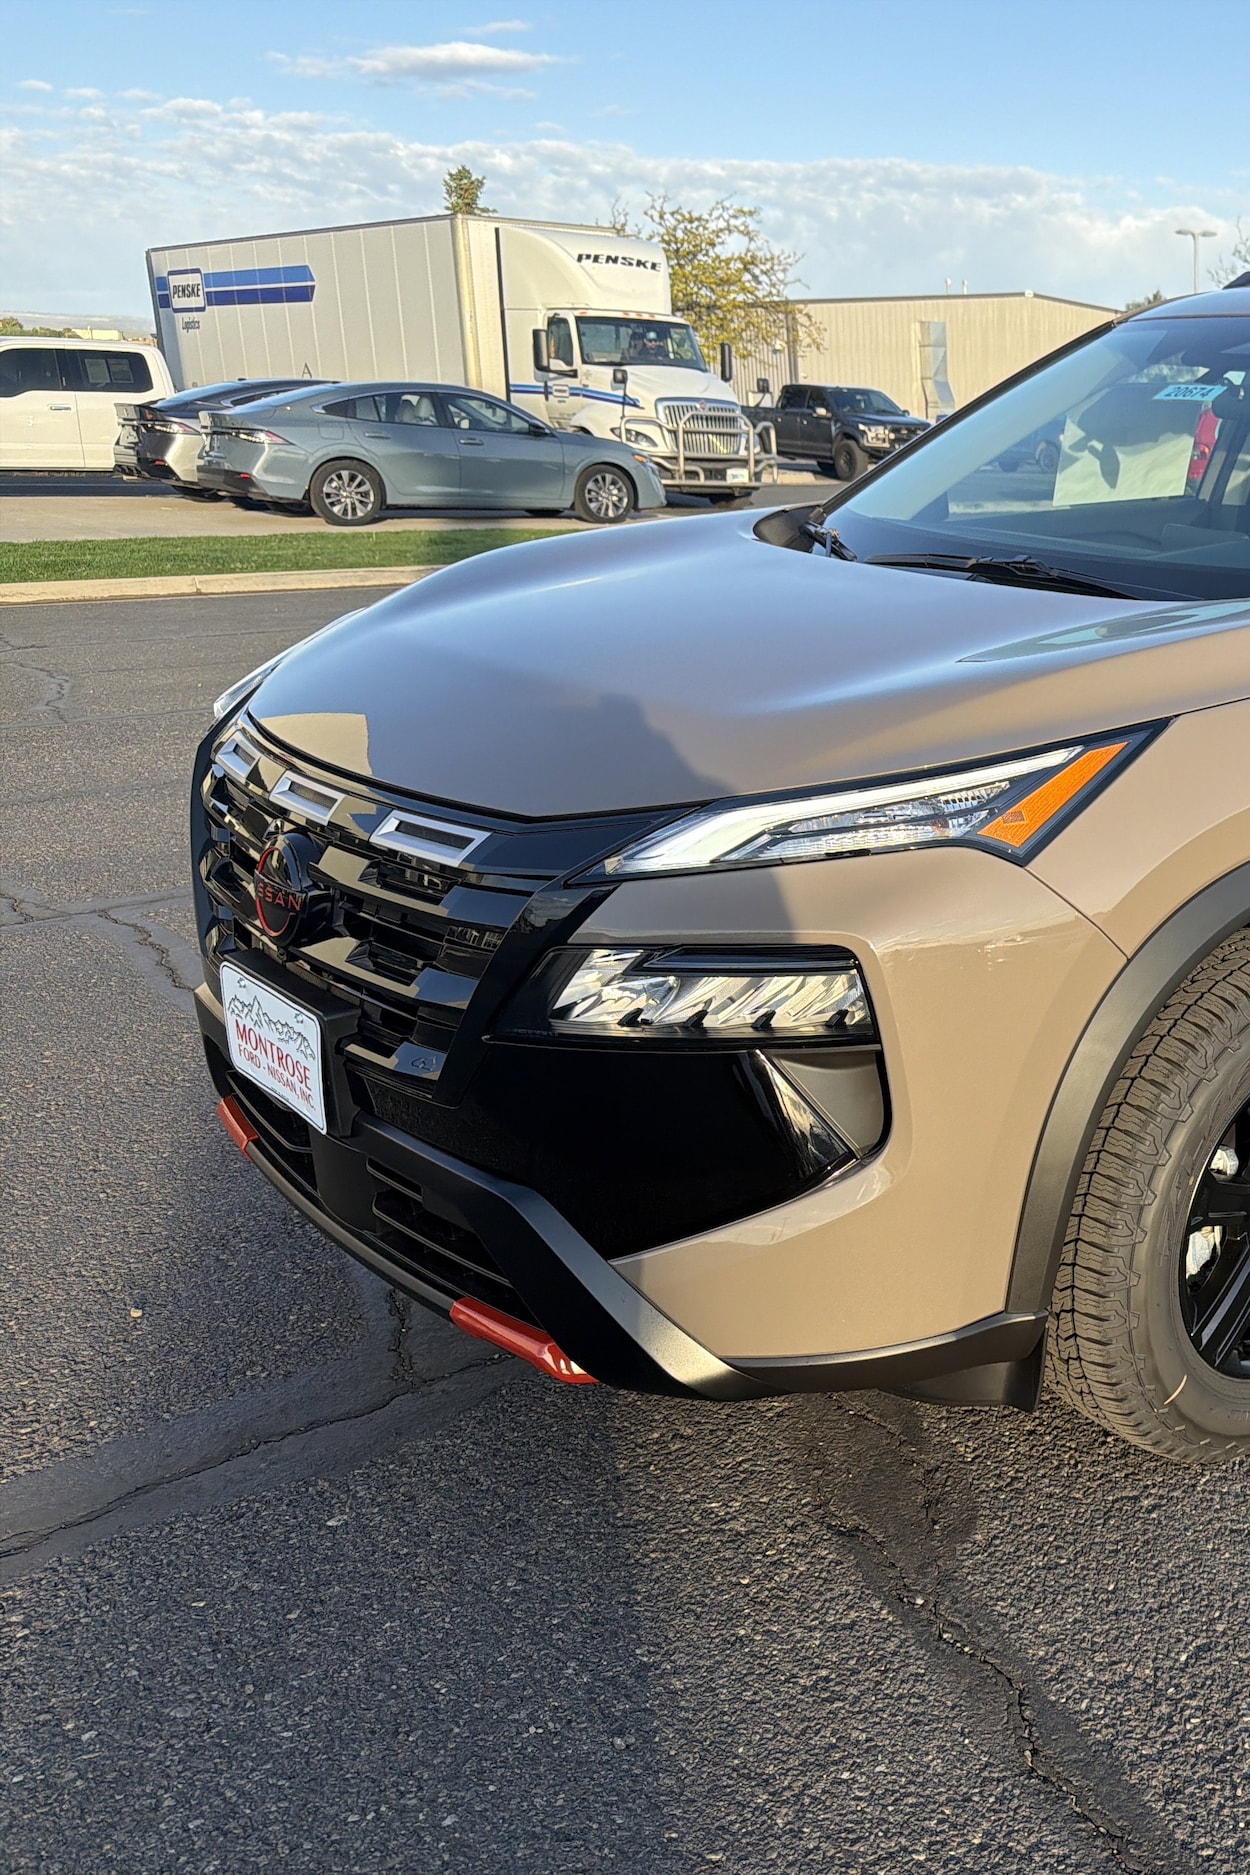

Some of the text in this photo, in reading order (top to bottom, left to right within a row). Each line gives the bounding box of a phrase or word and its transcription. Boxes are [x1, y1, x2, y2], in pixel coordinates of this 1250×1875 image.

[577, 253, 662, 272] PENSKE
[172, 283, 201, 299] PENSKE
[181, 316, 201, 334] Logistics
[1164, 386, 1215, 398] 20674
[257, 882, 303, 911] SSAN
[235, 1019, 312, 1092] MONTROSE
[238, 1043, 261, 1071] FORD
[267, 1062, 300, 1100] NISSAN,
[299, 1086, 316, 1111] INC.
